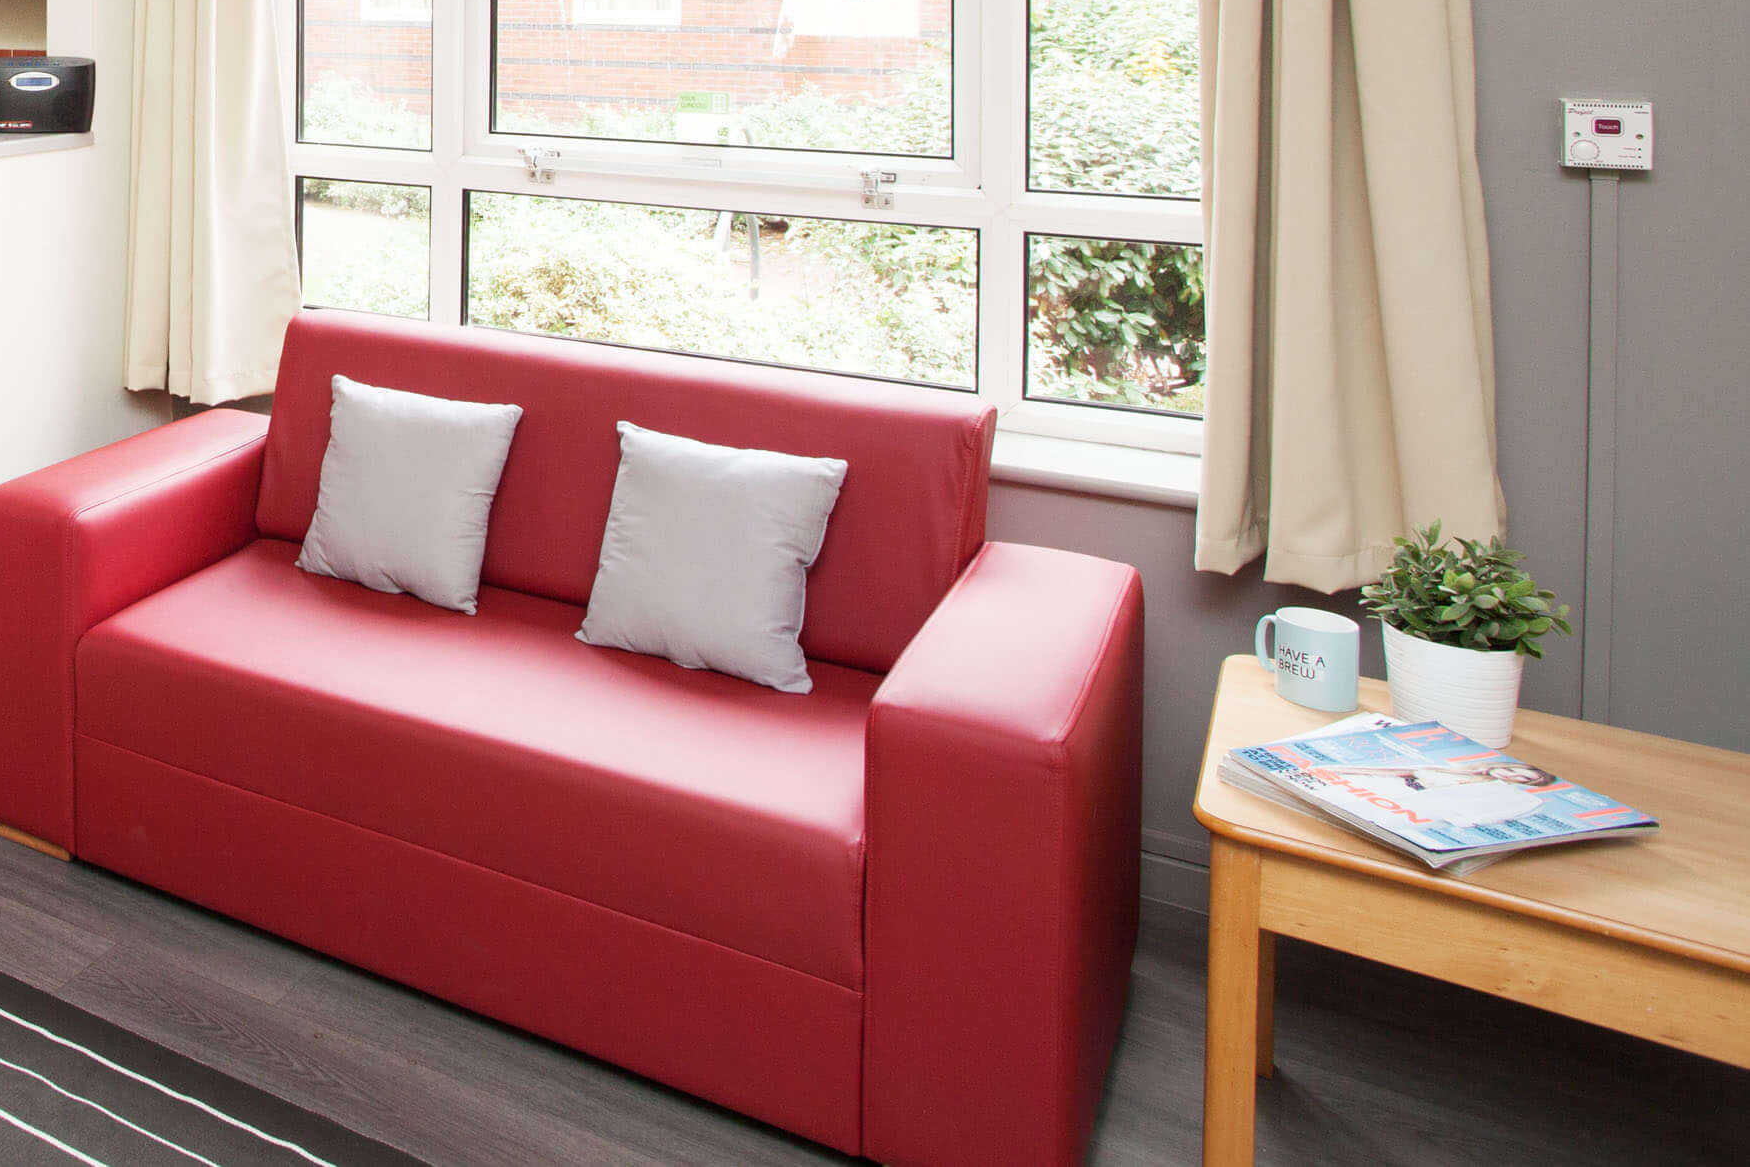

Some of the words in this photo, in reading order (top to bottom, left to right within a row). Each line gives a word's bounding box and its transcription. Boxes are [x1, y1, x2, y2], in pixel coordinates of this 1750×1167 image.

[1278, 643, 1310, 665] HAVE
[1315, 656, 1326, 668] A
[1278, 657, 1316, 680] BREW
[1267, 745, 1434, 824] FASHION
